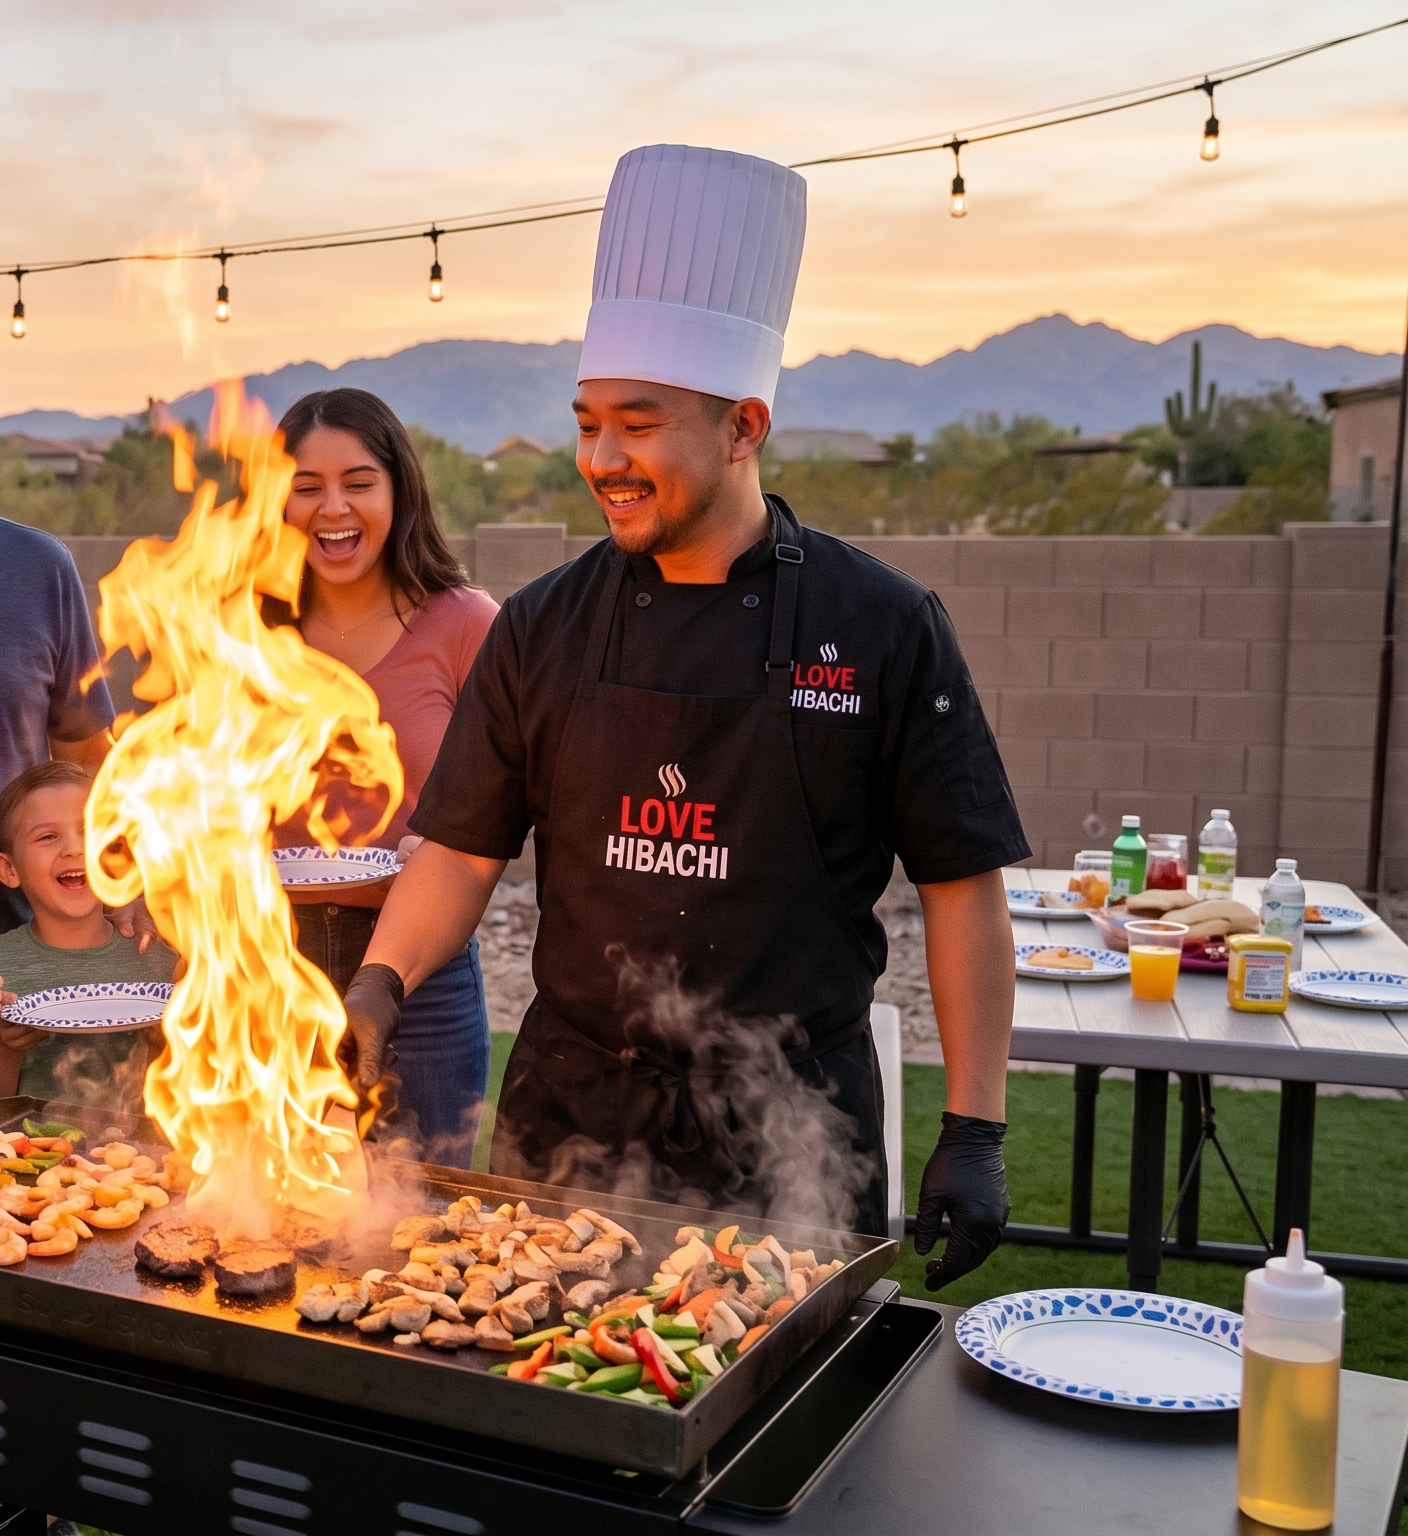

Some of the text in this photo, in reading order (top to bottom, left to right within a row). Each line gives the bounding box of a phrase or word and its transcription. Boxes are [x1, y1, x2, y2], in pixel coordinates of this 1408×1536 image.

[794, 663, 856, 691] LOVE
[620, 795, 716, 842] LOVE
[605, 834, 729, 880] HIBACHI
